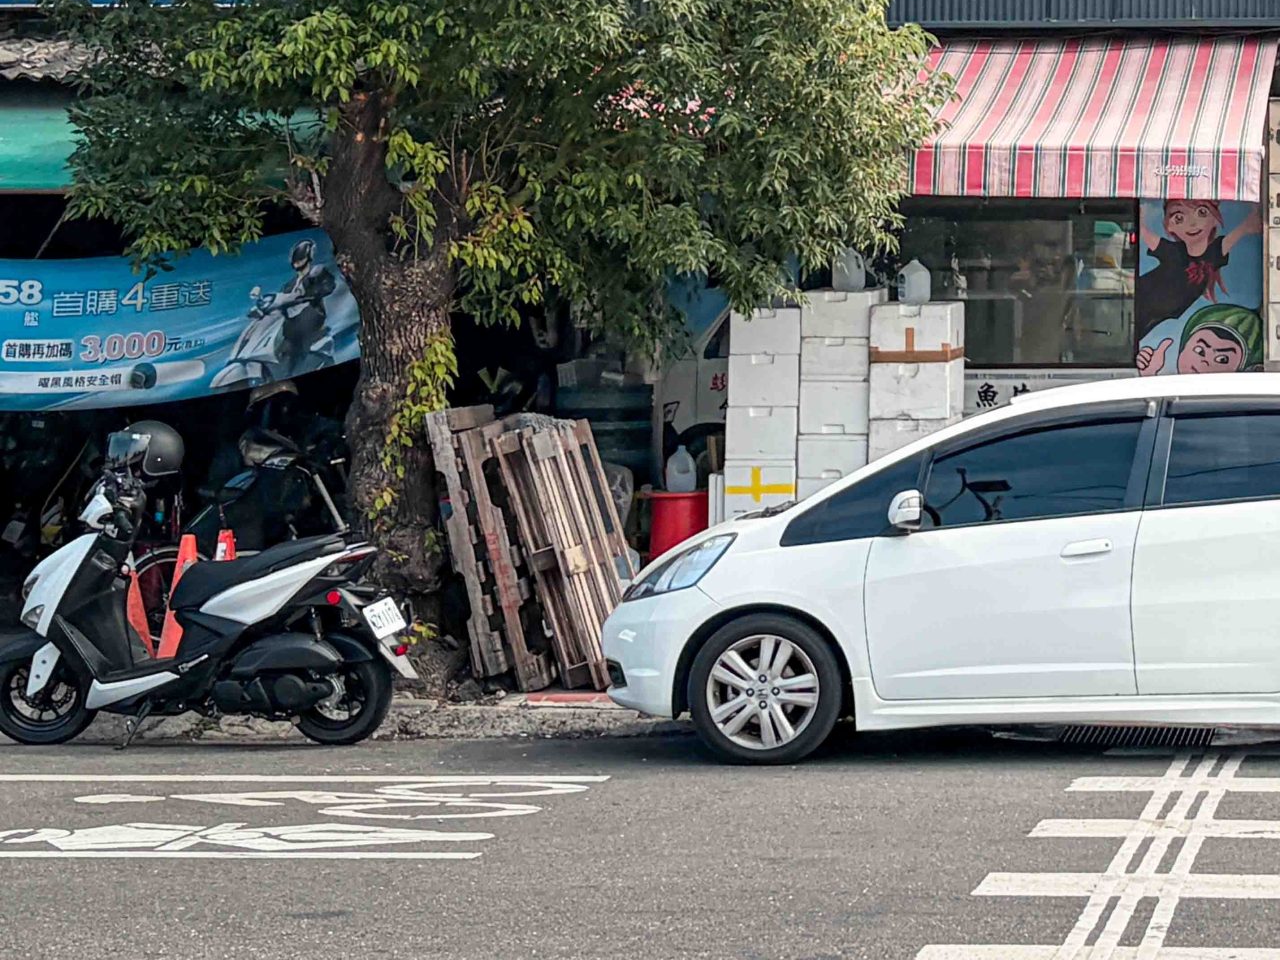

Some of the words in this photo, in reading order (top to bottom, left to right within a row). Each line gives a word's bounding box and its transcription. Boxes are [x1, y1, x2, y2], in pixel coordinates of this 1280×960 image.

[53, 281, 212, 317] 首購4重送
[5, 342, 72, 359] 首購再加碼
